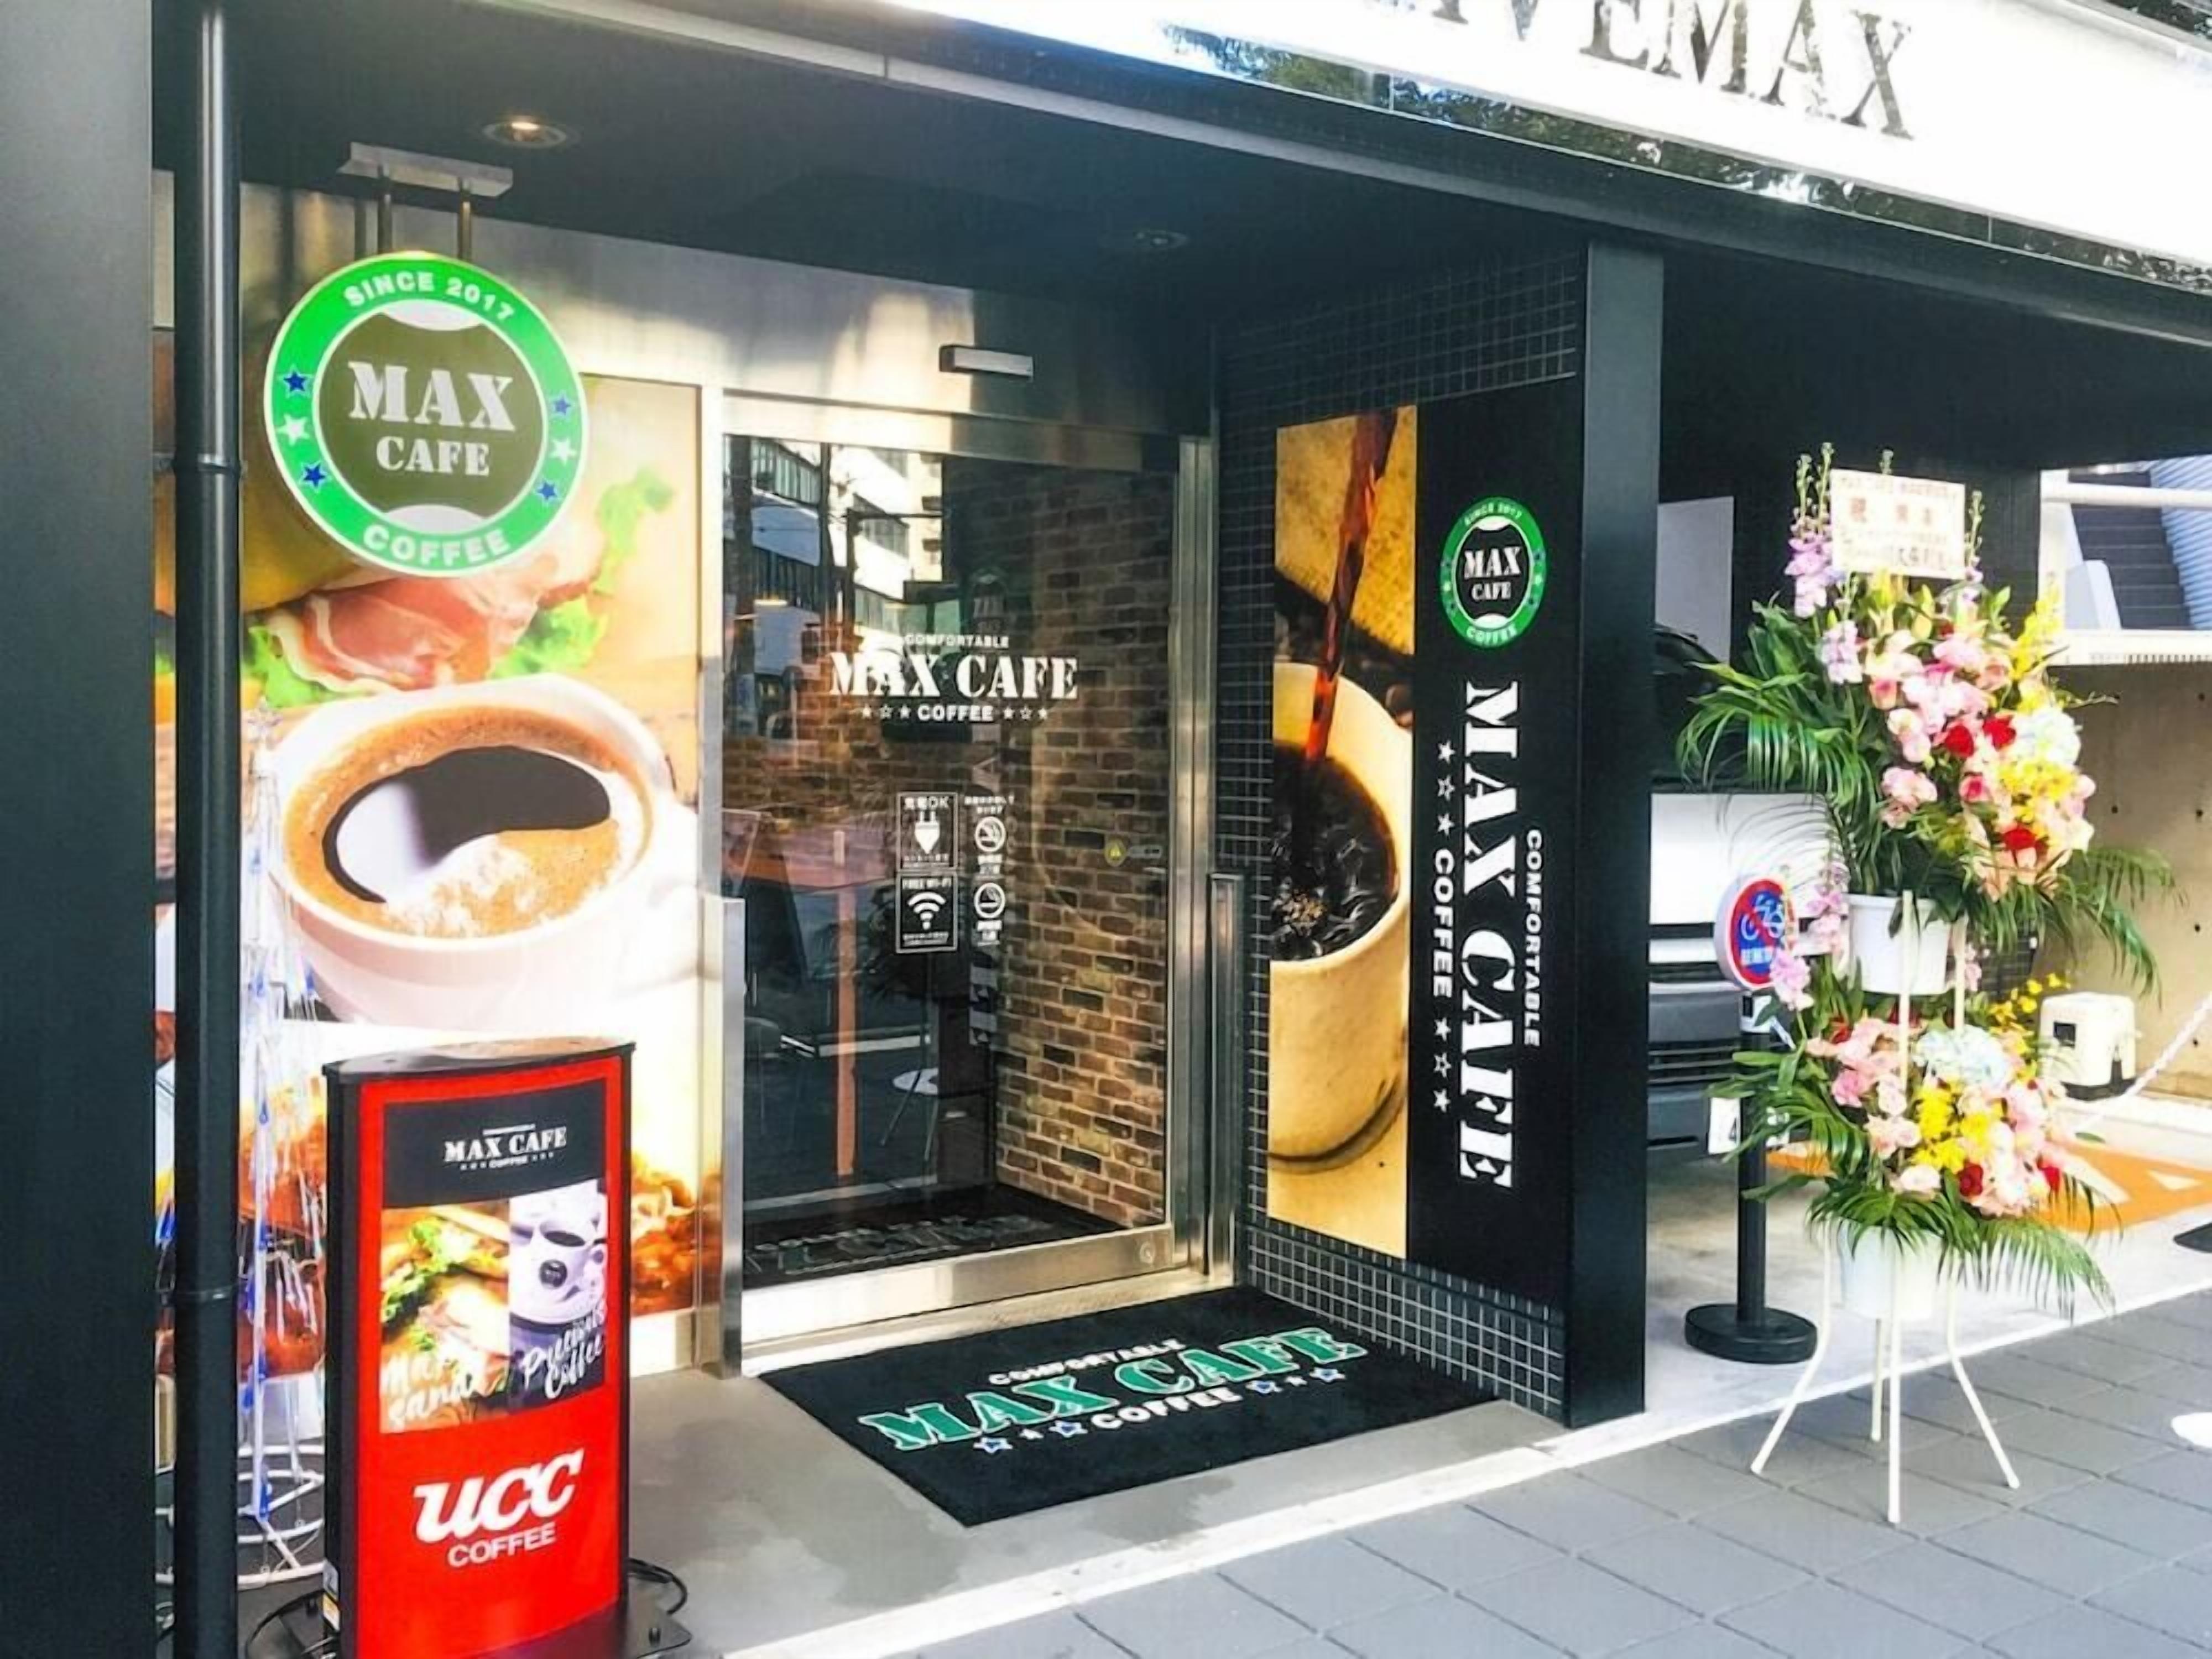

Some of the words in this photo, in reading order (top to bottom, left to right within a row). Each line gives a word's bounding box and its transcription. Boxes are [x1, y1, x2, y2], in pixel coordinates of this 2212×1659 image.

[343, 272, 434, 306] SINCE
[447, 278, 514, 319] 2017
[348, 361, 515, 431] MAX
[377, 436, 490, 476] CAFE
[363, 526, 512, 566] COFFEE
[1464, 546, 1521, 579] MAX
[1472, 582, 1511, 601] CAFE
[905, 633, 1009, 649] COMFORTABLE
[830, 653, 940, 697] MAX
[955, 655, 1078, 699] CAFE
[917, 705, 994, 722] COFFEE
[1463, 680, 1519, 898] MAX
[1433, 848, 1455, 999] COFFEE
[1524, 828, 1542, 1047] COMFORTABLE
[1460, 929, 1516, 1189] CAFE
[444, 1138, 502, 1162] MAX
[509, 1126, 567, 1155] CAFE
[989, 1339, 1186, 1385] COMFORTABLE
[859, 1375, 1120, 1451] MAX
[1115, 1327, 1369, 1396] CAFE
[1091, 1387, 1243, 1428] COFFEE
[447, 1521, 556, 1568] COFFEE
